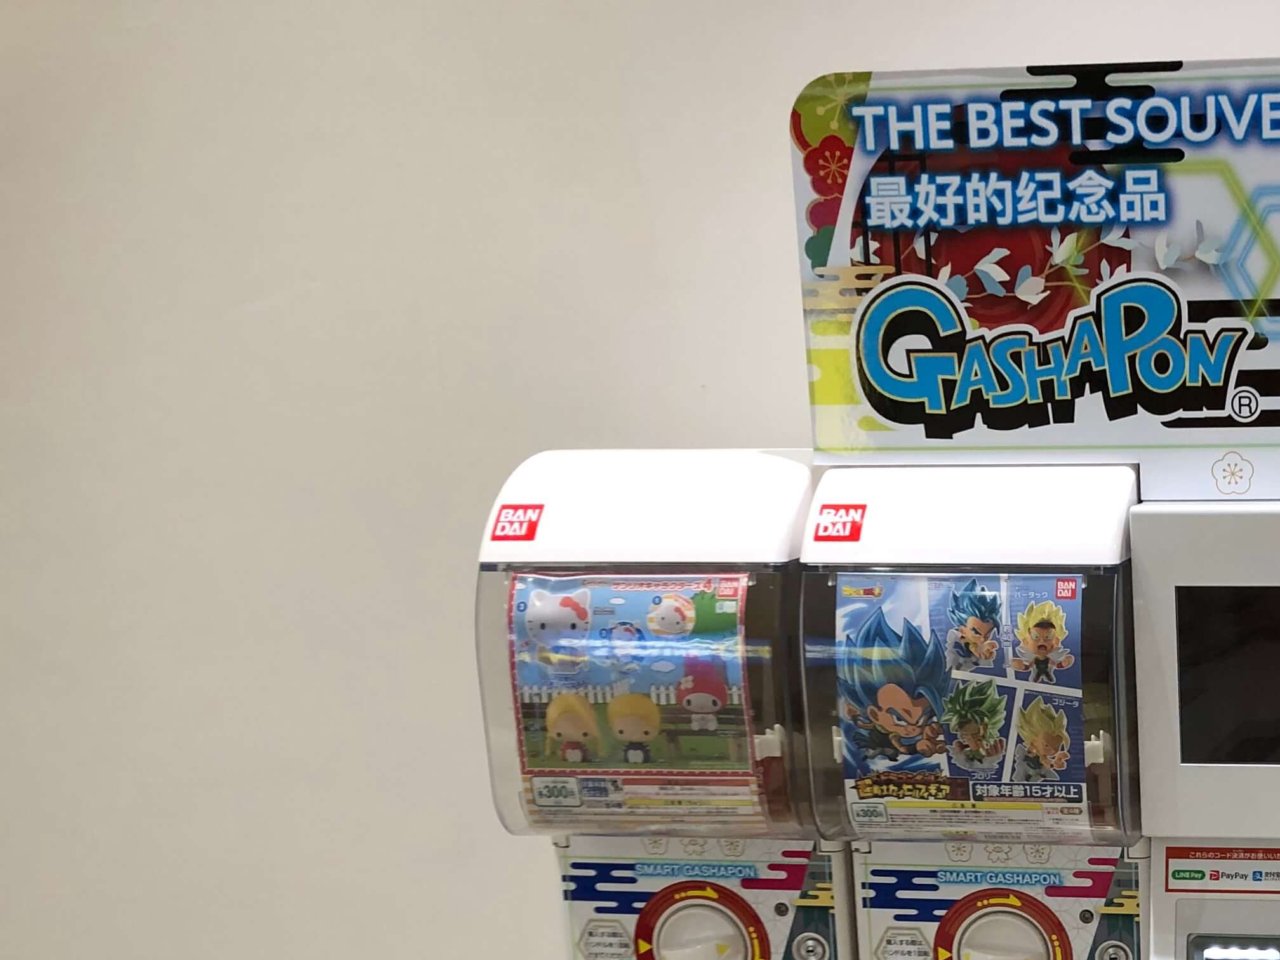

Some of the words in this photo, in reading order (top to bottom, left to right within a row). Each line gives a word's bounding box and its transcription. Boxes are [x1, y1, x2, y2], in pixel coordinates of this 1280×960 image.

[852, 105, 954, 152] THE
[968, 98, 1091, 149] BEST
[865, 168, 1168, 229] 最好的纪念品
[859, 278, 1246, 414] GASHAPON
[975, 785, 1079, 798] 対象年齢15才以上
[635, 863, 680, 877] SMART
[683, 864, 755, 878] GASHAPON
[937, 871, 983, 884] SMART
[986, 872, 1060, 885] GASHAPON
